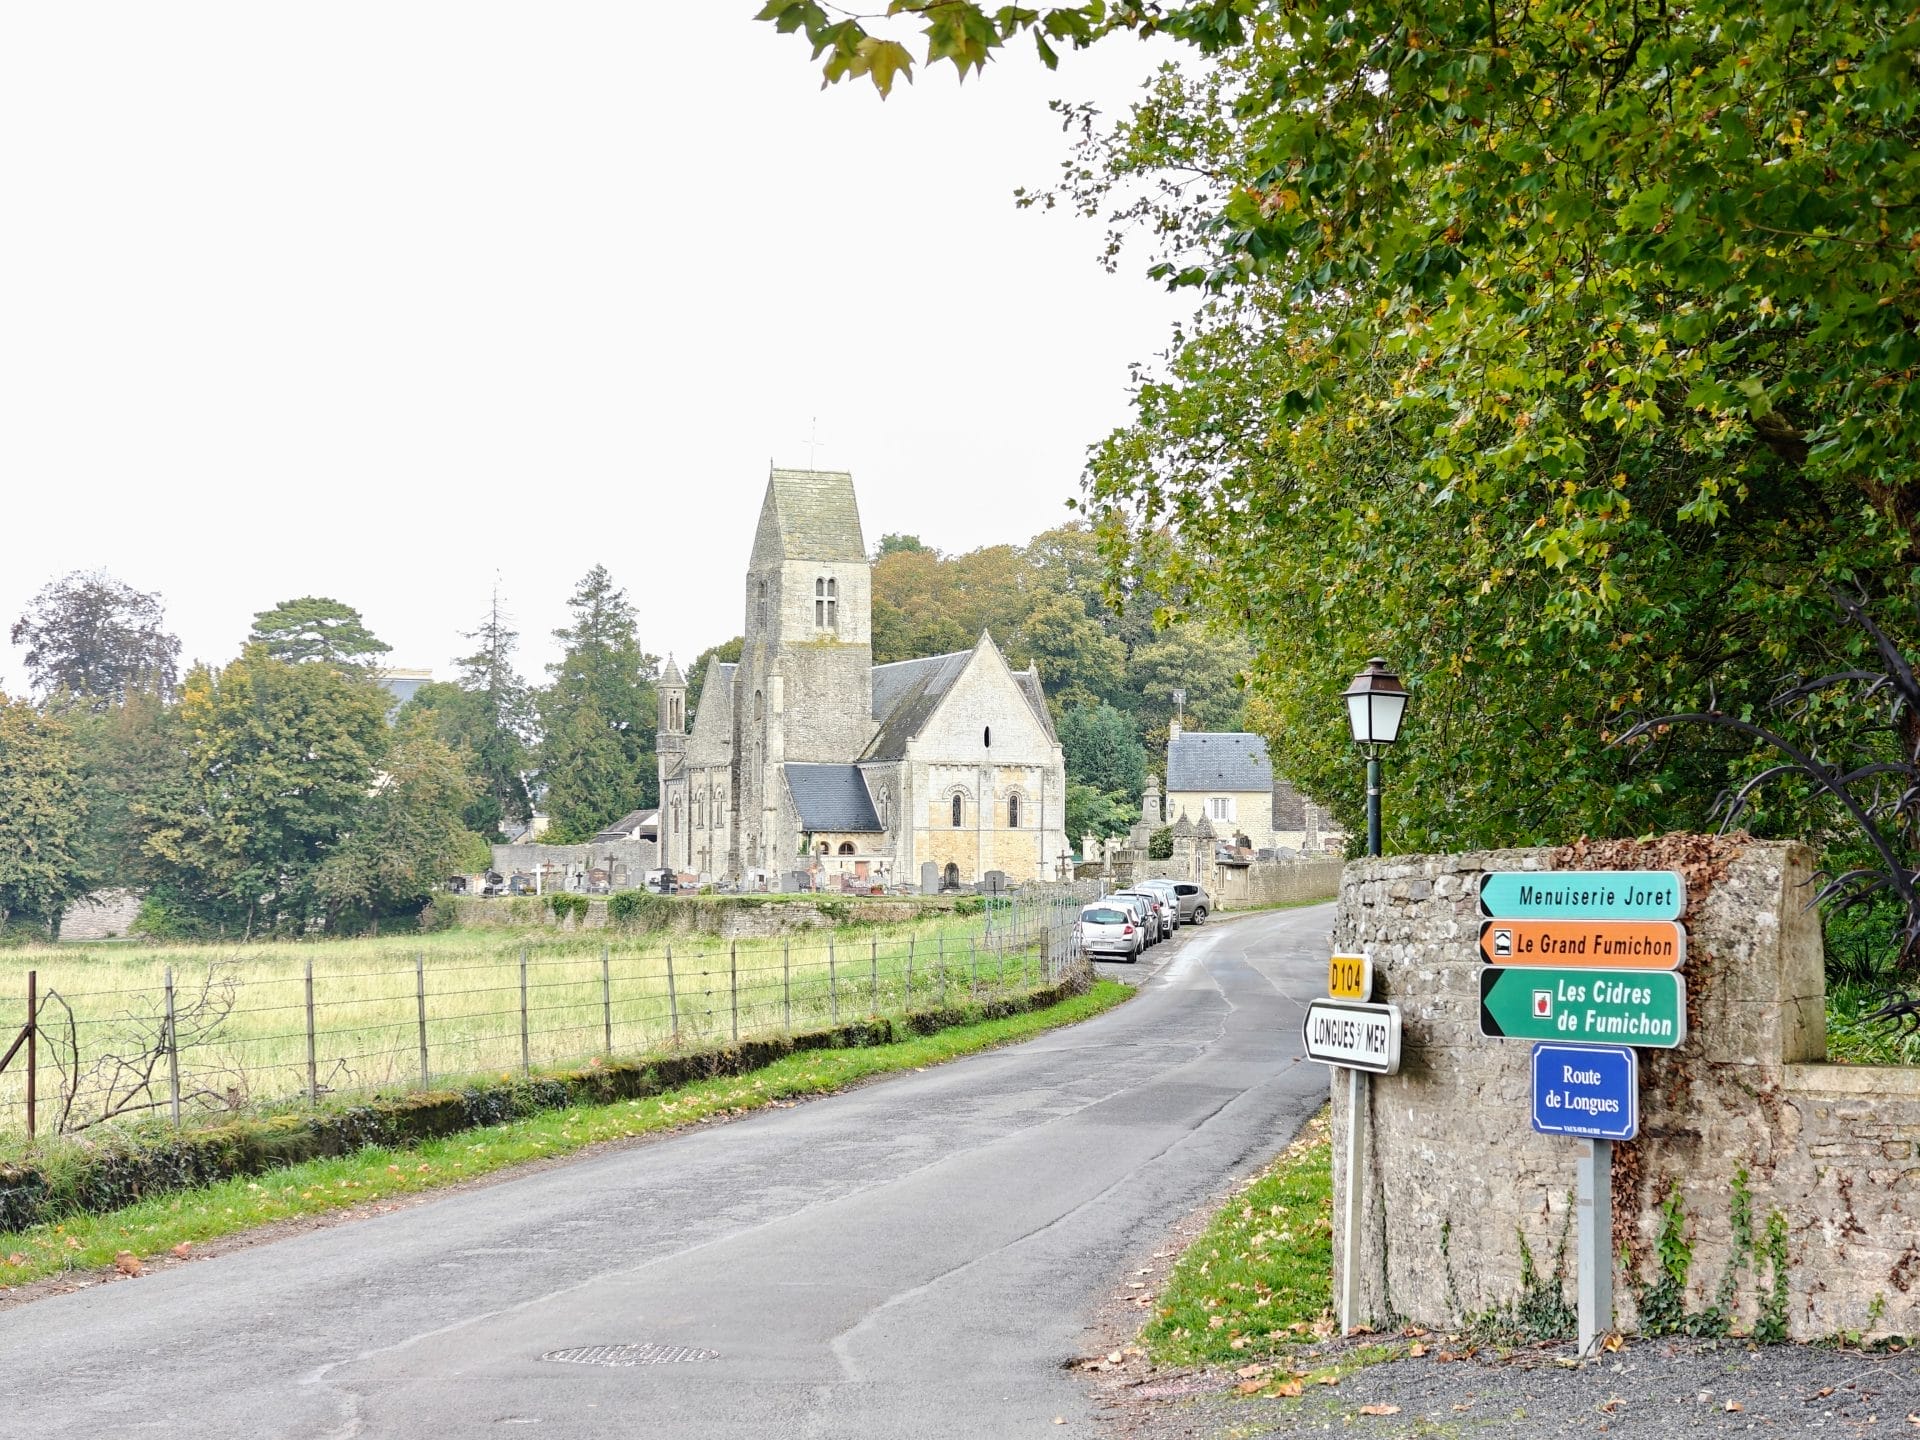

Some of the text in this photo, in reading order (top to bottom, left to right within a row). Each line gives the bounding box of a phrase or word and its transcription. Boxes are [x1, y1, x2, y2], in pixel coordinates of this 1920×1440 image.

[1519, 886, 1672, 906] Menuiserie Joret
[1517, 934, 1672, 956] Le Grand Fumichon
[1332, 963, 1361, 992] D 104
[1557, 979, 1652, 1005] Les Cidres
[1314, 1017, 1355, 1050] LONGUES
[1366, 1023, 1386, 1054] MER
[1557, 1009, 1672, 1036] de Fumichon
[1562, 1065, 1602, 1085] Route
[1545, 1090, 1619, 1116] de Longues
